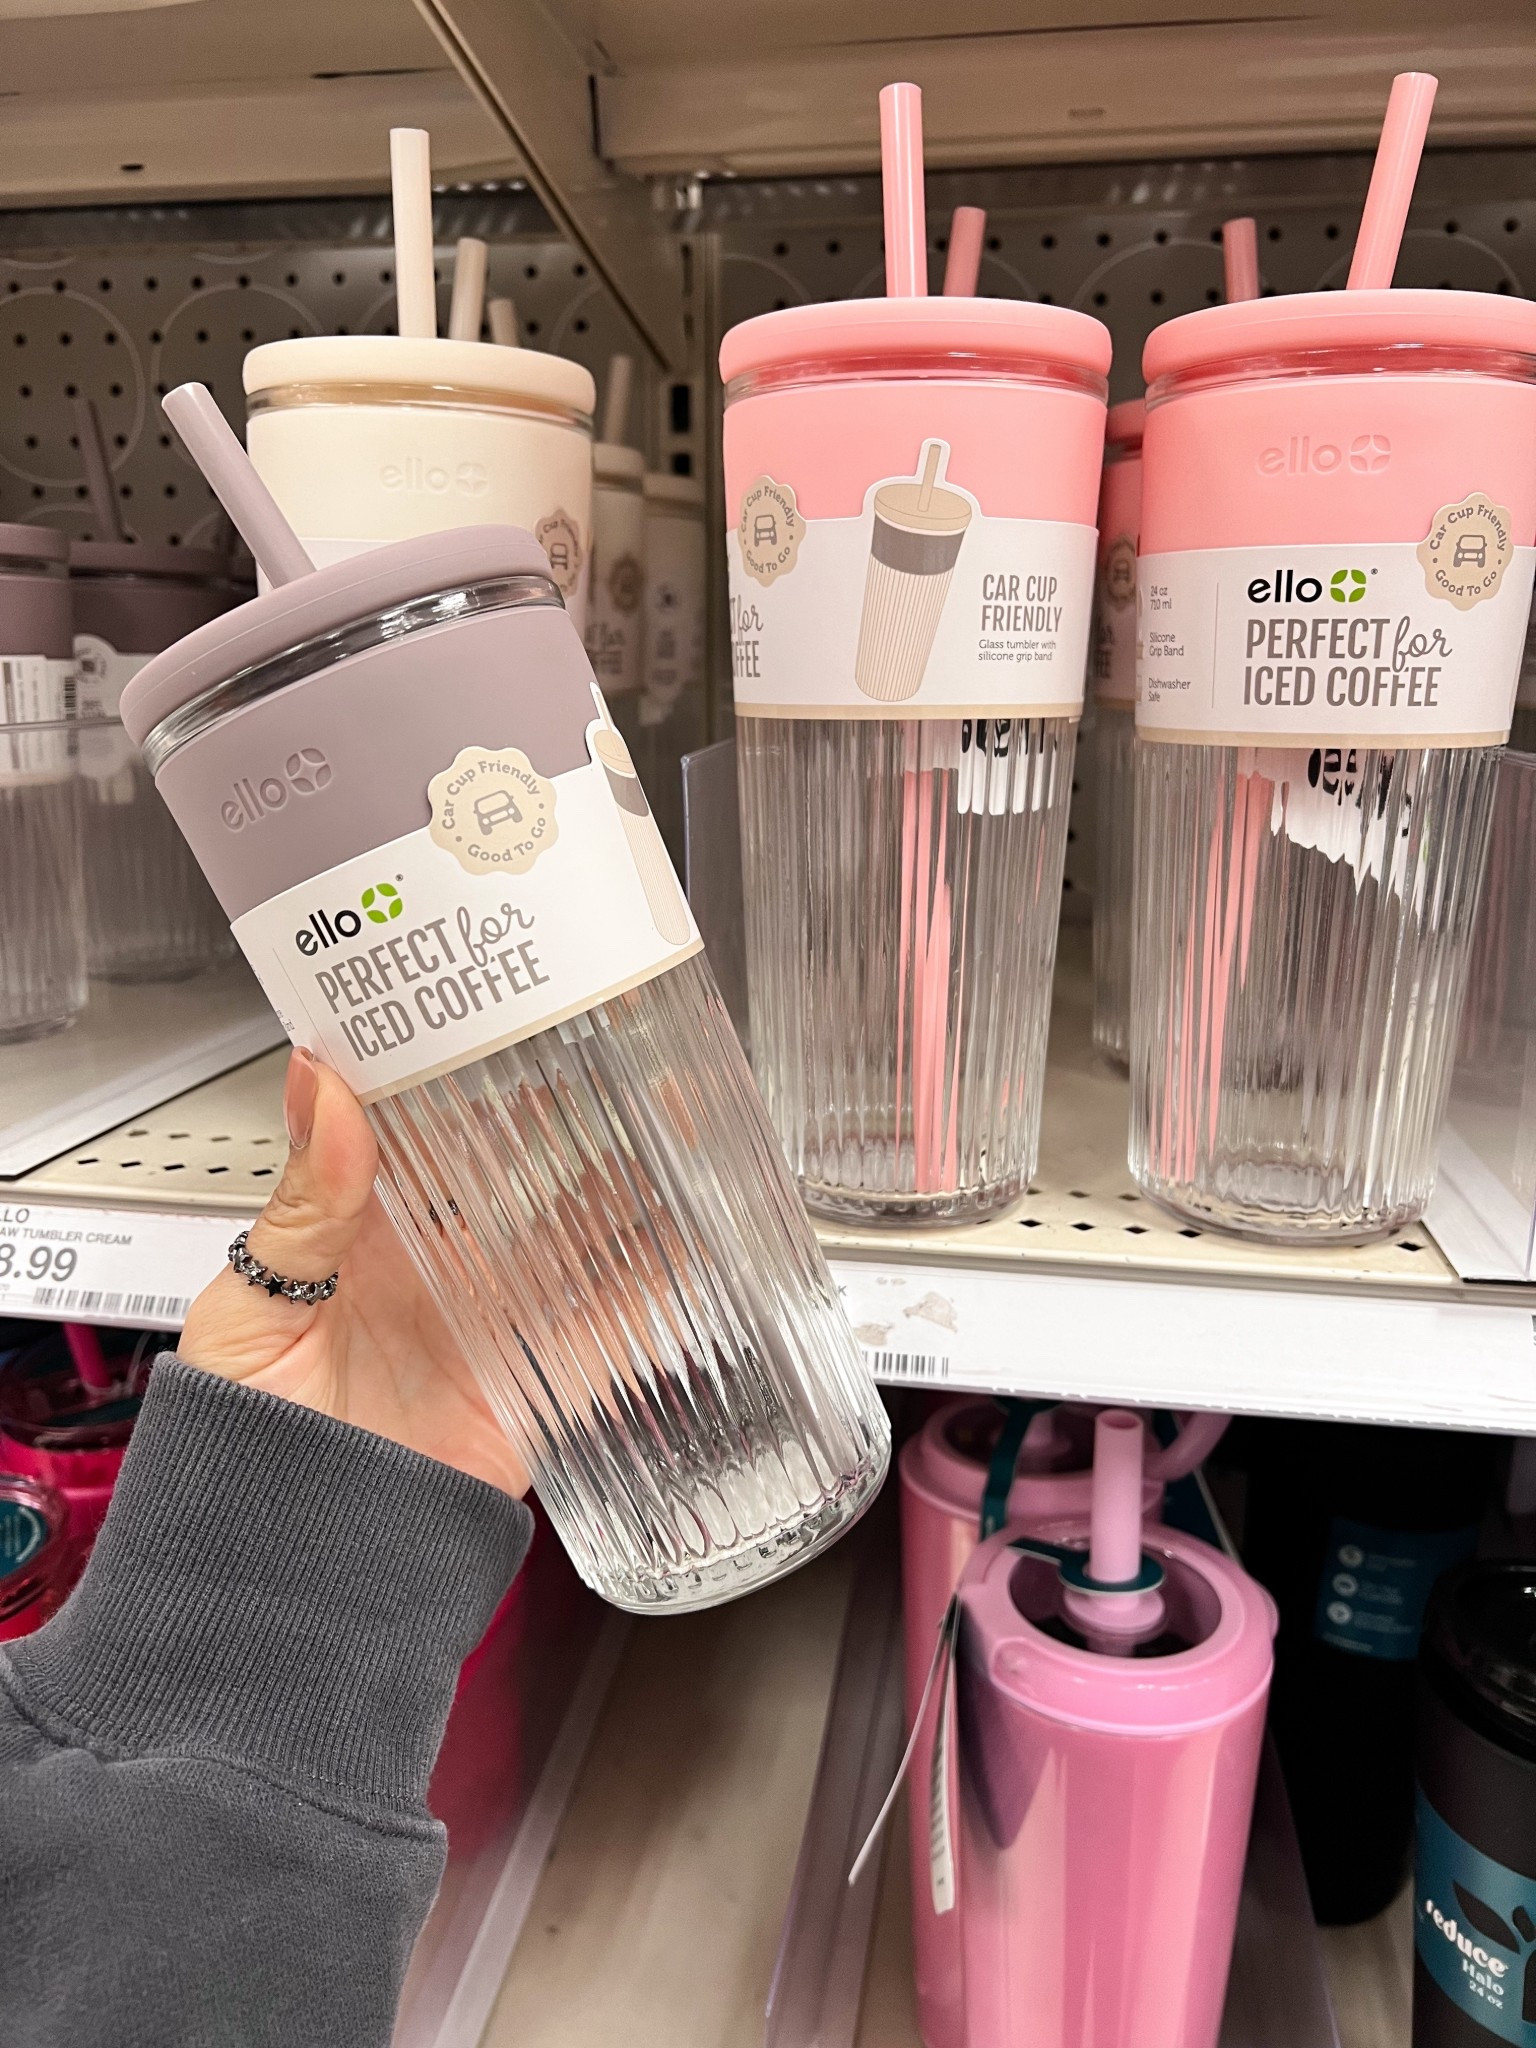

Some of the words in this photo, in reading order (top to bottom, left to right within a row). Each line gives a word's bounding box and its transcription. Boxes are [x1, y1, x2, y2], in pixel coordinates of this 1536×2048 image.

[1258, 436, 1342, 475] ello
[380, 457, 449, 493] ello
[746, 490, 762, 507] Cup
[764, 486, 795, 527] Friendly
[1430, 524, 1447, 550] Car
[1447, 506, 1474, 524] Cup
[1477, 504, 1507, 551] Friendly
[766, 562, 777, 573] To
[778, 546, 790, 564] Go
[982, 574, 1020, 601] CAR
[1026, 575, 1058, 602] CUP
[1150, 585, 1158, 596] 24
[1247, 570, 1323, 603] ello
[1435, 569, 1464, 596] Good
[1467, 585, 1481, 596] To
[1483, 571, 1497, 588] Go
[982, 604, 1063, 632] FRIENDLY
[1162, 598, 1172, 610] ml
[978, 639, 1004, 649] Glass
[1006, 640, 1040, 650] tumbler
[1040, 640, 1056, 650] with
[1149, 646, 1162, 658] Grip
[1164, 645, 1184, 656] Band
[1150, 632, 1176, 642] Silicone
[1246, 618, 1390, 659] PERFECT
[1391, 615, 1453, 674] for
[978, 651, 1014, 661] silicone
[1016, 652, 1032, 663] grip
[1034, 652, 1053, 661] band
[1148, 678, 1191, 690] Dishwasher
[1148, 690, 1160, 702] Safe
[1244, 666, 1316, 706] ICED
[1326, 666, 1442, 706] COFFEE
[446, 768, 476, 796] Cup
[478, 760, 541, 796] Friendly
[221, 778, 288, 831] ello
[442, 800, 456, 830] Car
[468, 843, 514, 862] Good
[514, 840, 534, 856] To
[530, 817, 546, 838] Go
[295, 909, 362, 956] ello
[314, 917, 457, 1015] PERFECT
[456, 902, 535, 968] for
[340, 1000, 416, 1062] ICED
[414, 938, 551, 1030] COFFEE
[23, 1228, 83, 1242] TUMBLER
[86, 1232, 134, 1245] CREAM
[1426, 1899, 1505, 1978] reduce
[1462, 1958, 1504, 1996] Halo
[1469, 1980, 1484, 1997] 24
[1487, 1995, 1503, 2010] oz
